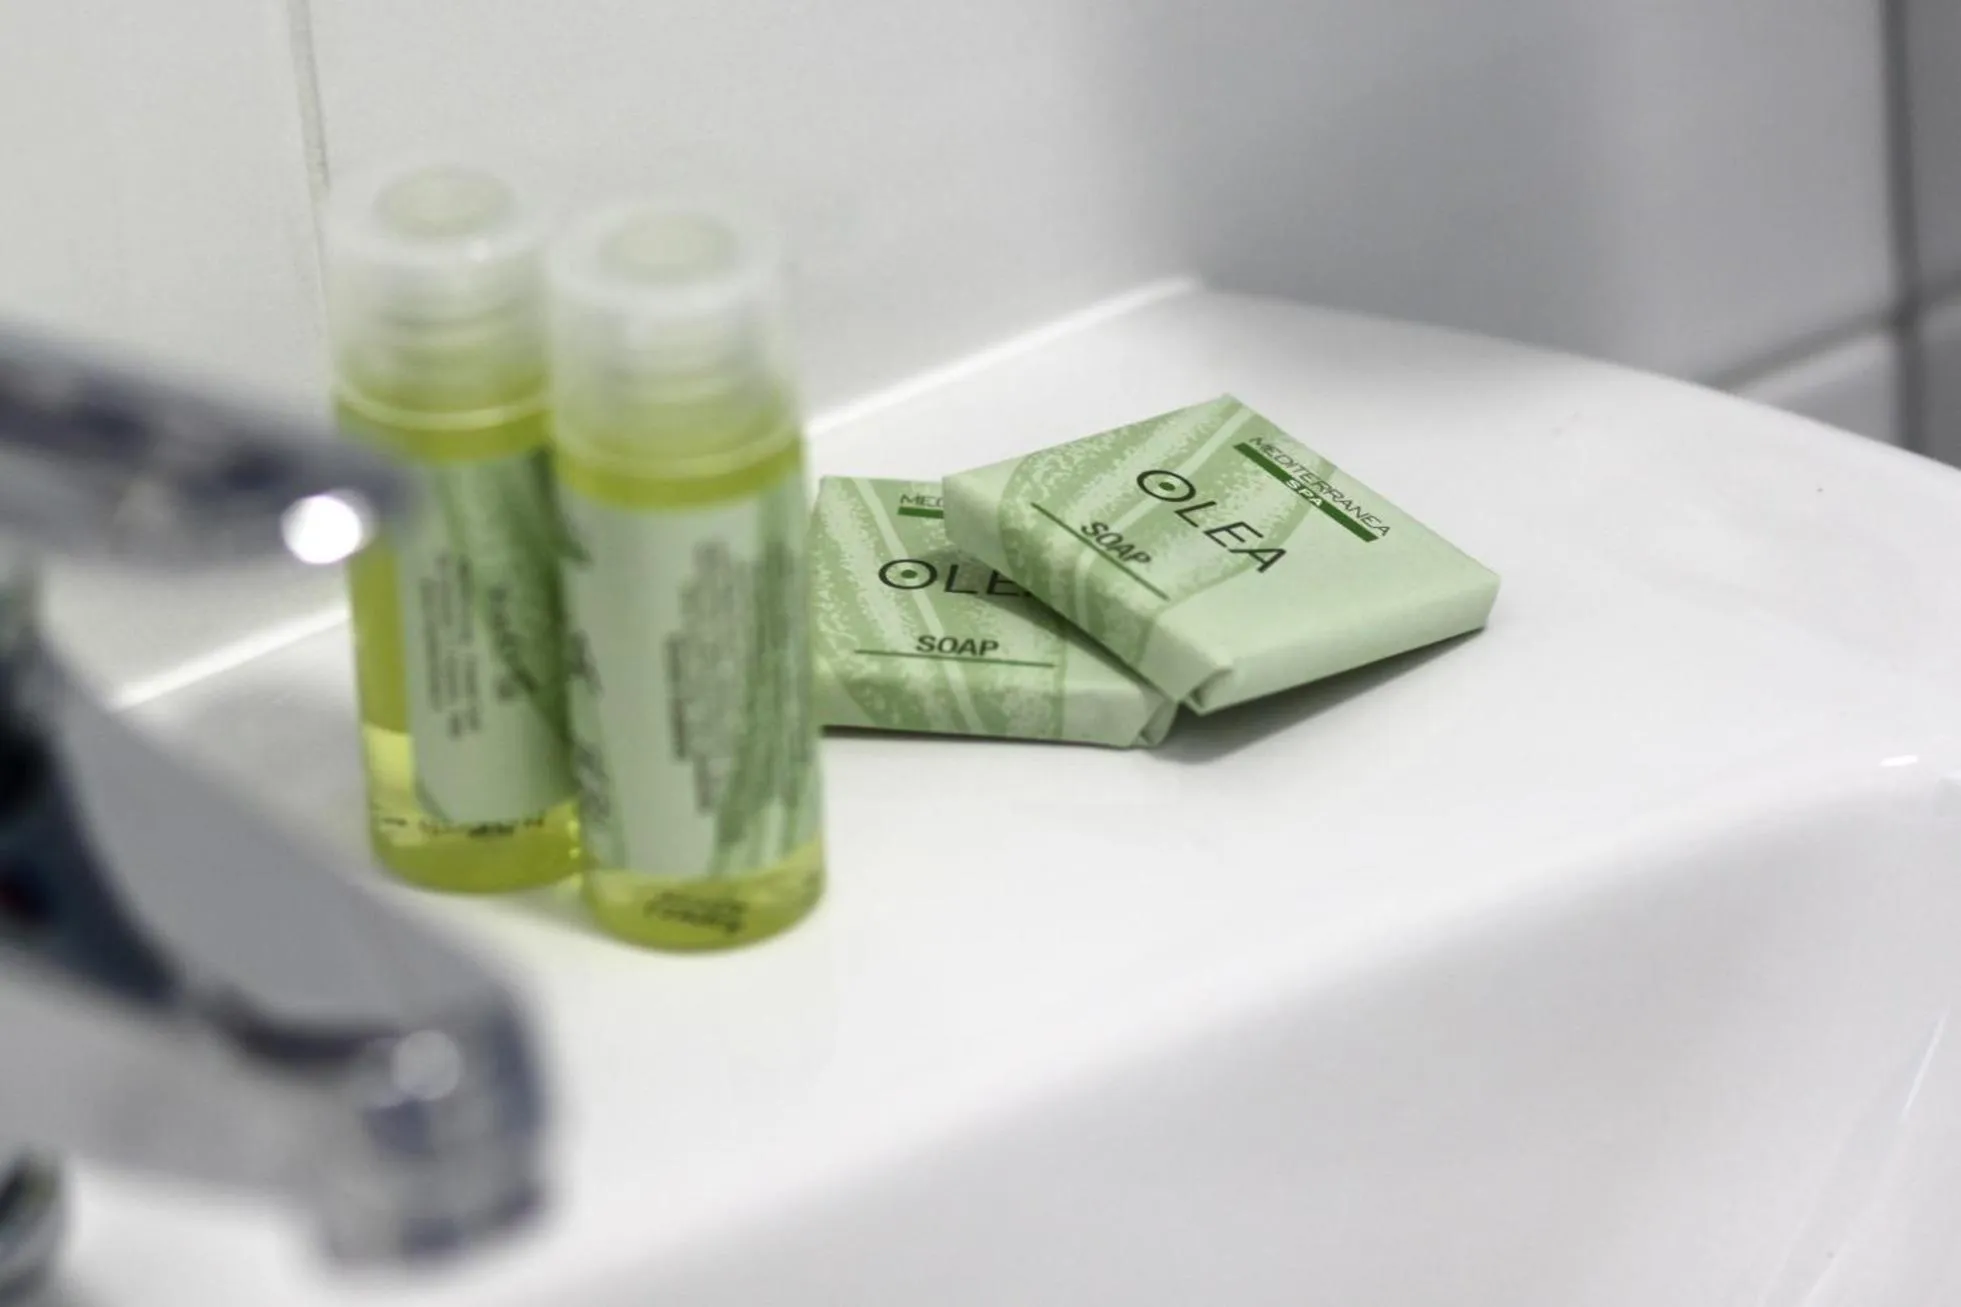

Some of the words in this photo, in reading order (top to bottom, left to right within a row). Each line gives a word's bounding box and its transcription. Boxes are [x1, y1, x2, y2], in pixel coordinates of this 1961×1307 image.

[1249, 436, 1390, 536] MEDITERRANEA
[1285, 479, 1323, 507] SPA
[1136, 469, 1287, 573] OLEA
[1080, 521, 1152, 564] SOAP
[878, 558, 1034, 598] OLE
[915, 634, 999, 656] SOAP
